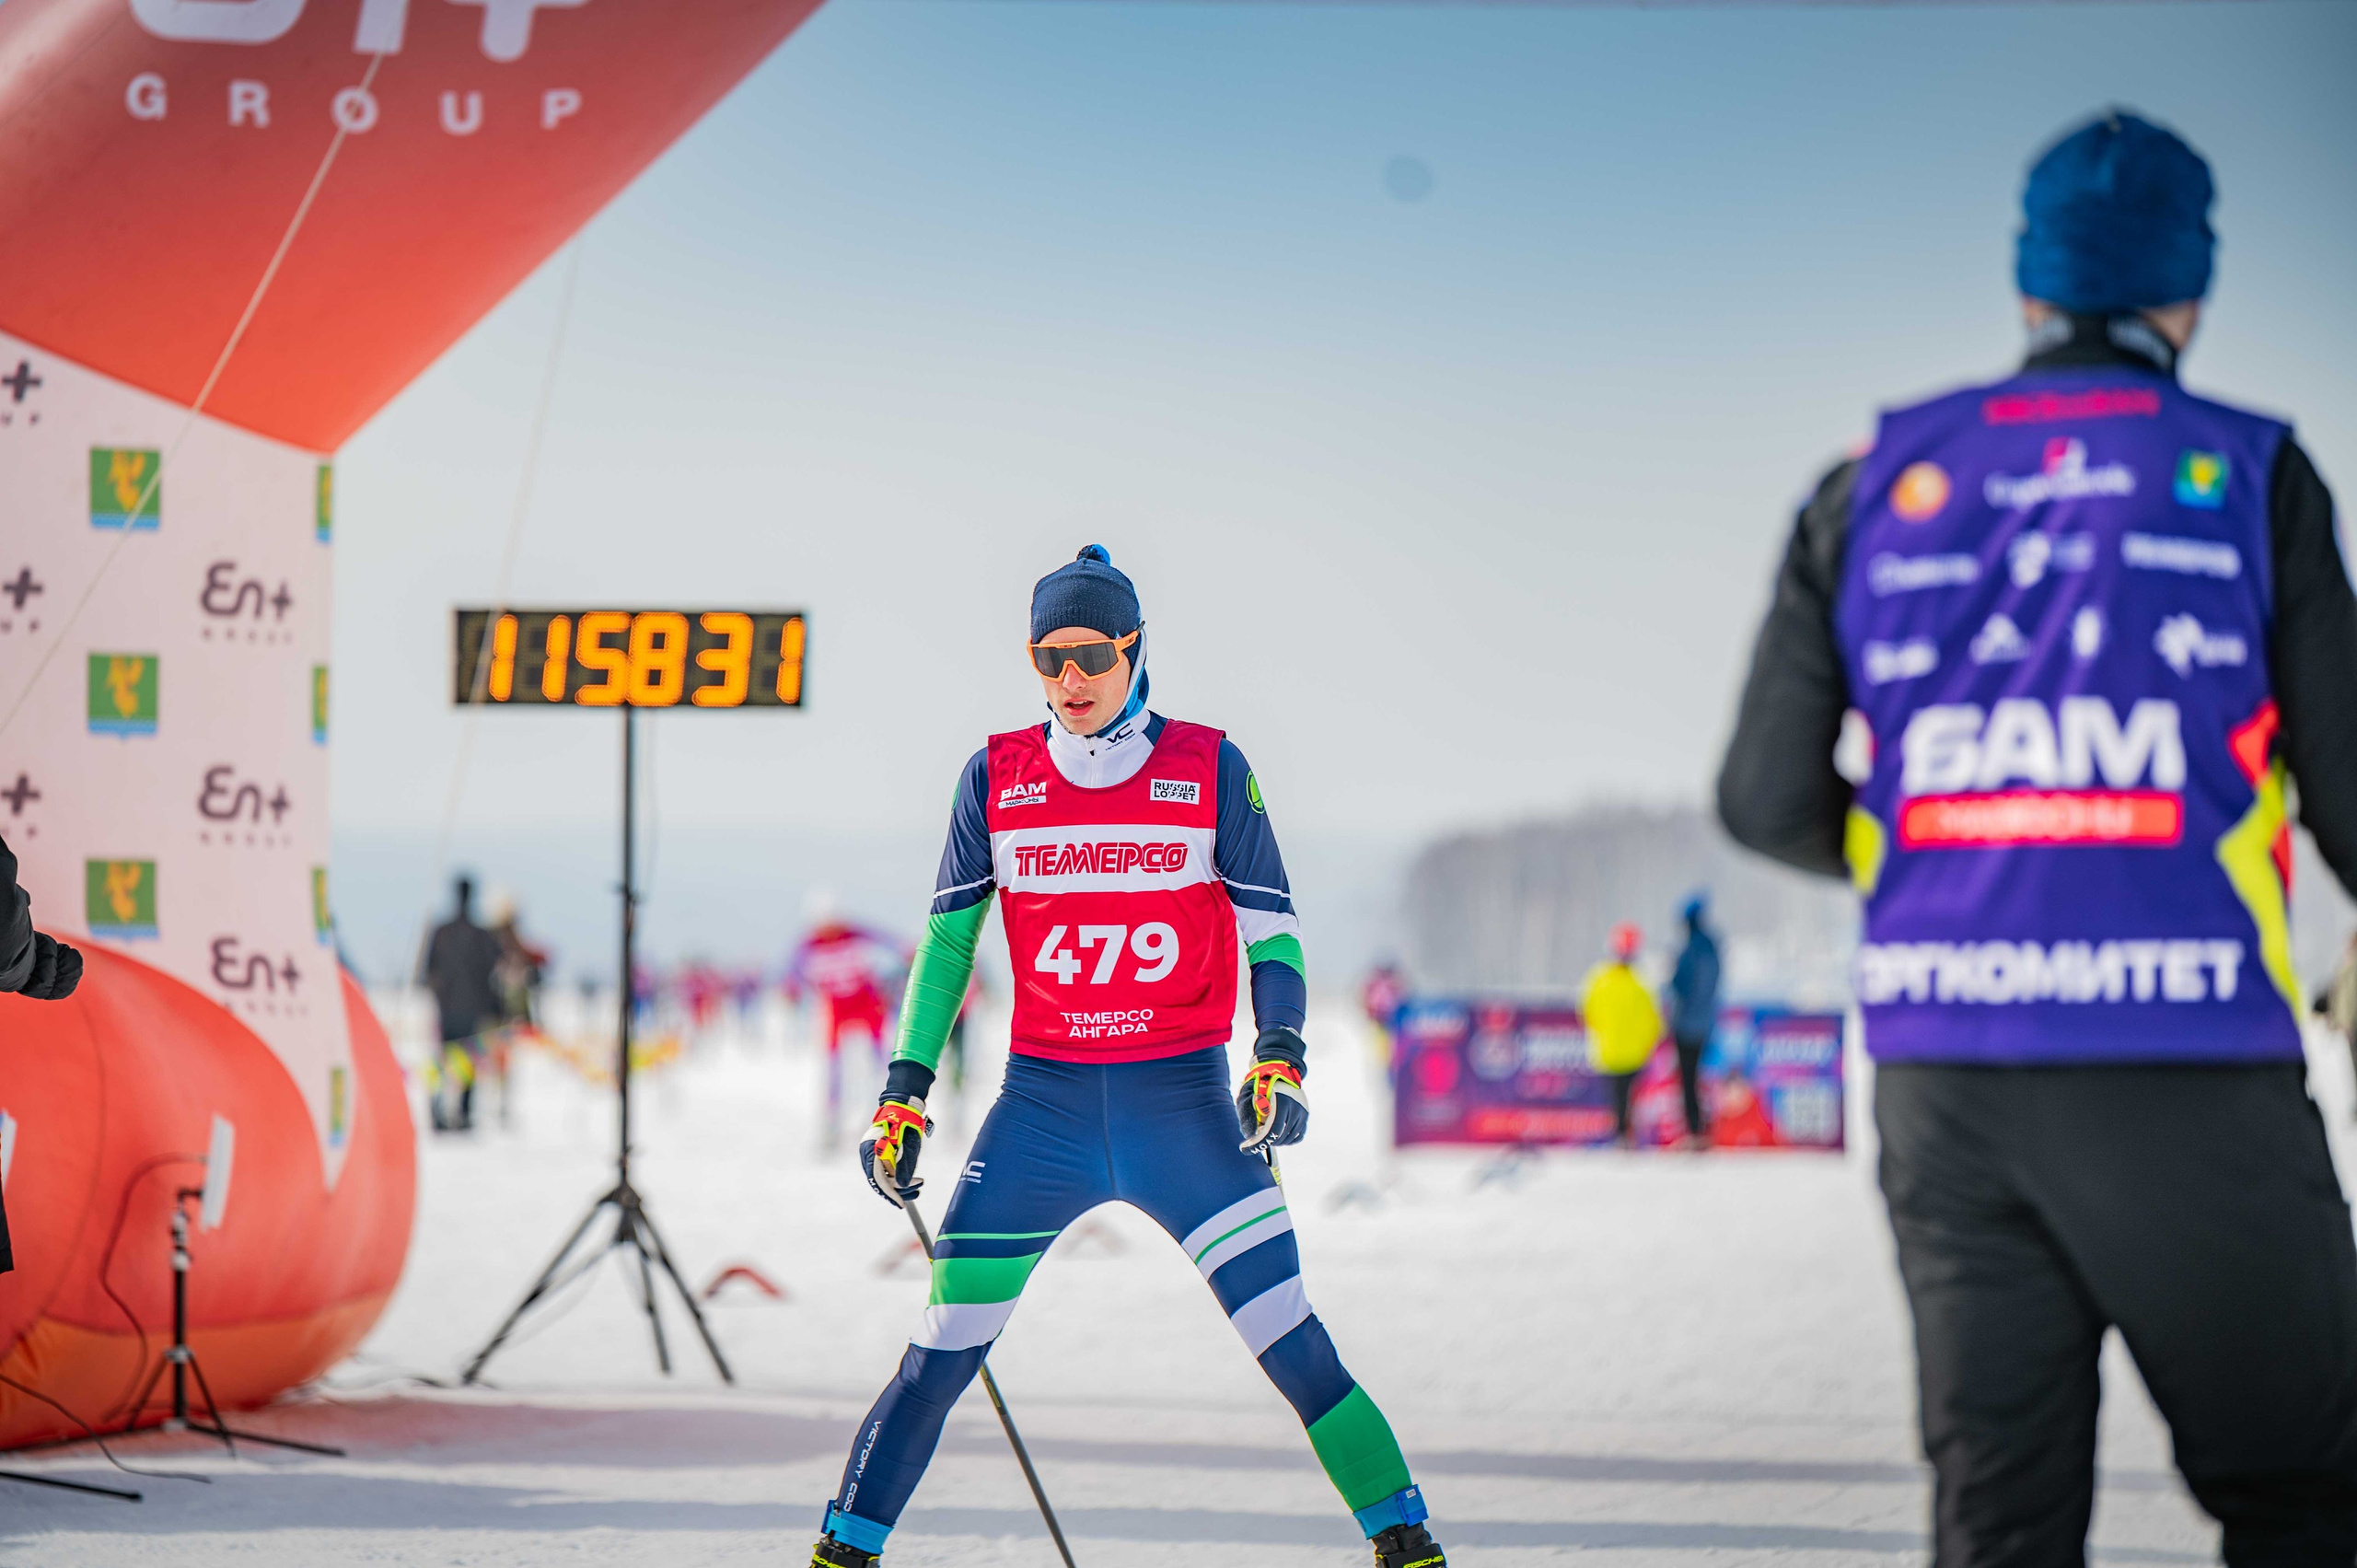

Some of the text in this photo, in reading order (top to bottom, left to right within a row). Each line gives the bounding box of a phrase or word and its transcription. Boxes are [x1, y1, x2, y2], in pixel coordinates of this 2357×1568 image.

[125, 73, 583, 135] GROUP
[1154, 782, 1196, 793] RUSSIA
[1154, 790, 1196, 801] LOPPET
[1016, 842, 1188, 877] ТЕМЕРСО
[1034, 922, 1180, 985] 479
[1060, 1008, 1154, 1025] ТЕМЕРСО
[1068, 1022, 1149, 1039] АНГАРА
[1250, 1132, 1279, 1155] MOAX
[843, 1421, 882, 1513] VICTORY COD
